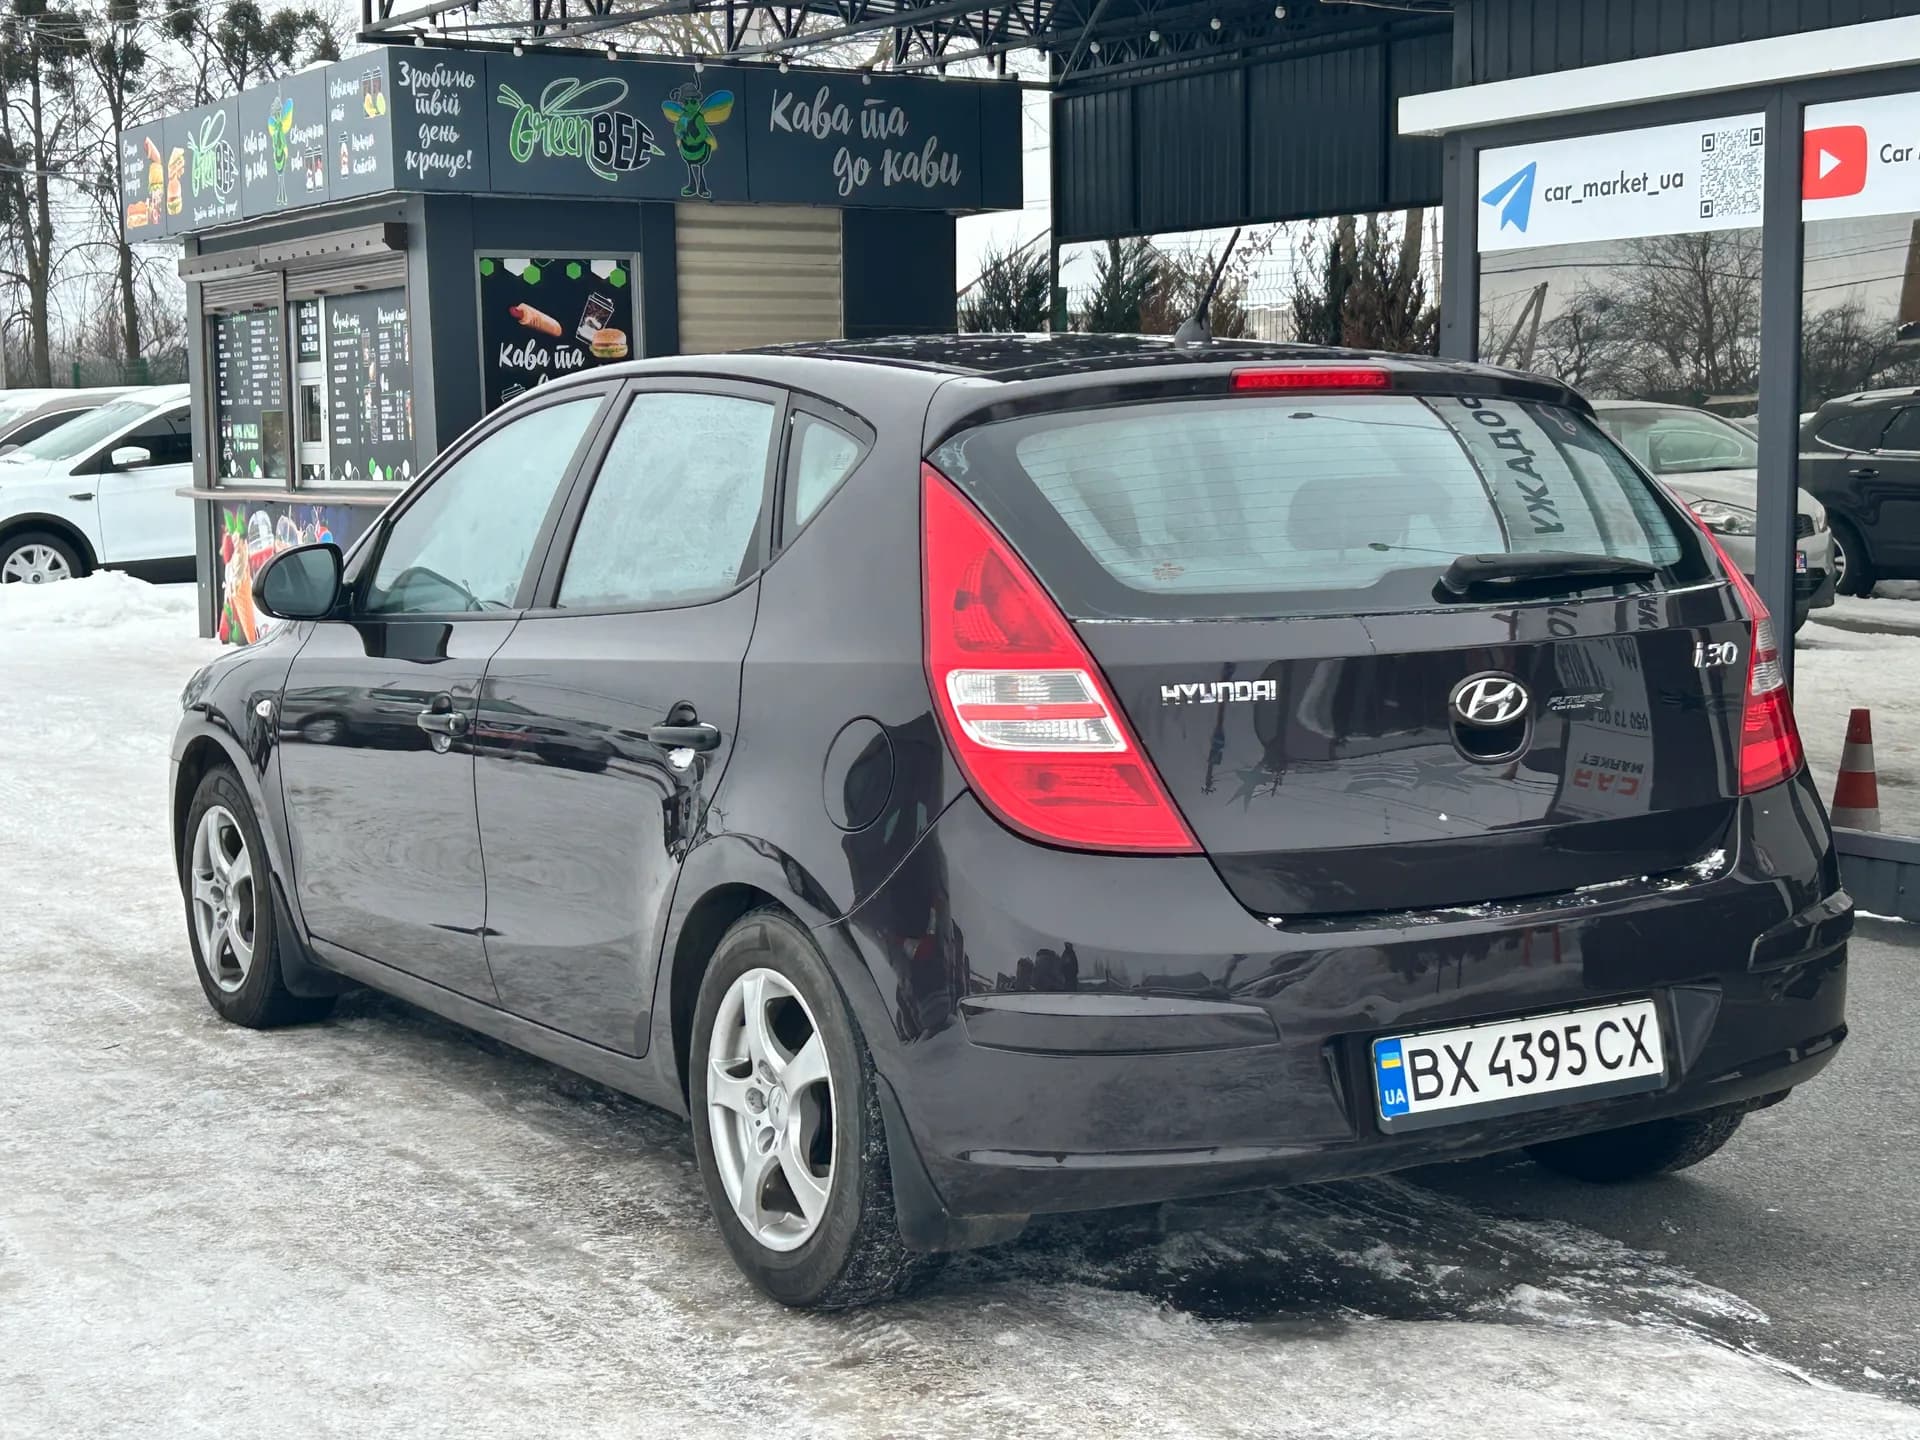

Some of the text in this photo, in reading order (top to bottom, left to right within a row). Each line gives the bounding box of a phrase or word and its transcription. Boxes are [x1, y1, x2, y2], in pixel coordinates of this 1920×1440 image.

[398, 60, 476, 96] Зробимо
[415, 88, 461, 116] твій
[770, 86, 909, 140] Кава та
[418, 122, 460, 149] день
[404, 149, 473, 180] краще!
[833, 136, 961, 196] до кави
[1880, 143, 1913, 164] Car
[1544, 169, 1684, 204] car_market_ua
[499, 338, 585, 371] Кава та
[1694, 641, 1738, 668] i30
[1160, 679, 1278, 707] HYUNDAI
[1408, 1014, 1654, 1101] BX 4395 CX
[1385, 1089, 1406, 1105] UA
